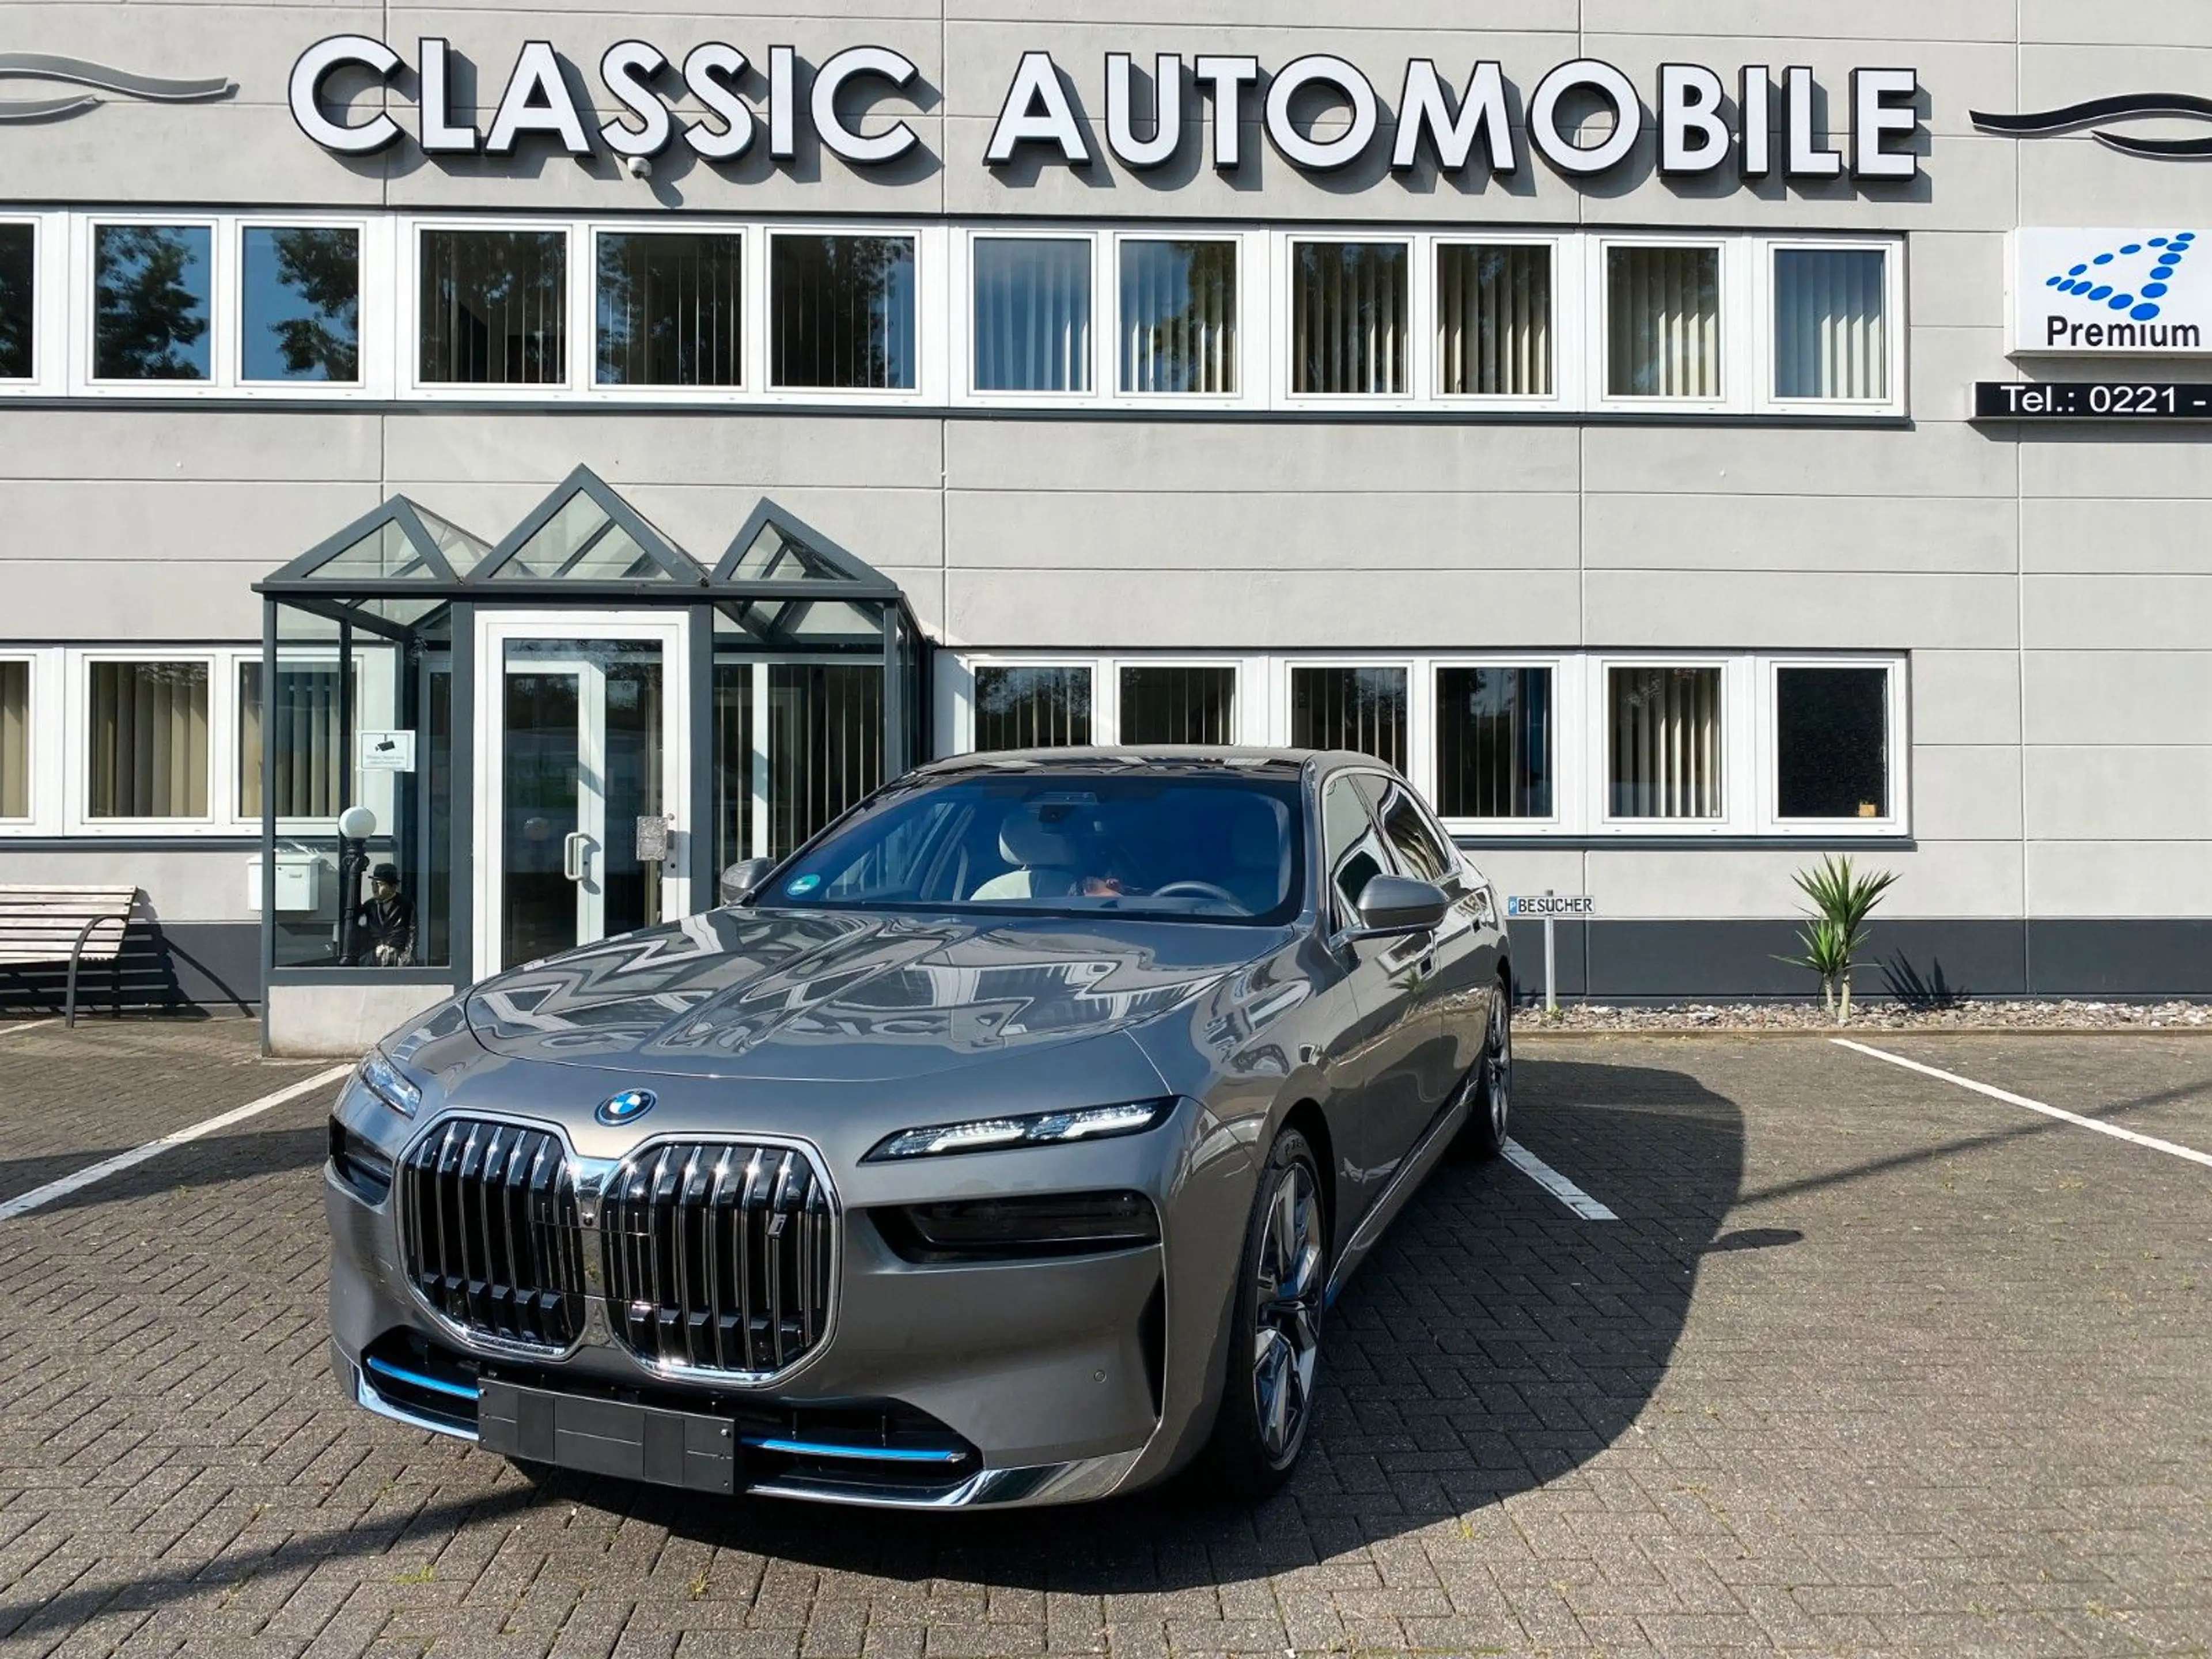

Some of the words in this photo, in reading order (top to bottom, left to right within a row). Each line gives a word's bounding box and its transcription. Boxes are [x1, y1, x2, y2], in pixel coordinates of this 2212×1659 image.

[289, 35, 919, 164] CLASSIC
[983, 51, 1919, 179] AUTOMOBILE
[2047, 315, 2200, 347] Premium
[2000, 385, 2075, 412] Tel.:
[2089, 385, 2175, 413] 0221
[1509, 901, 1516, 910] P
[1518, 898, 1593, 912] BESUCHER
